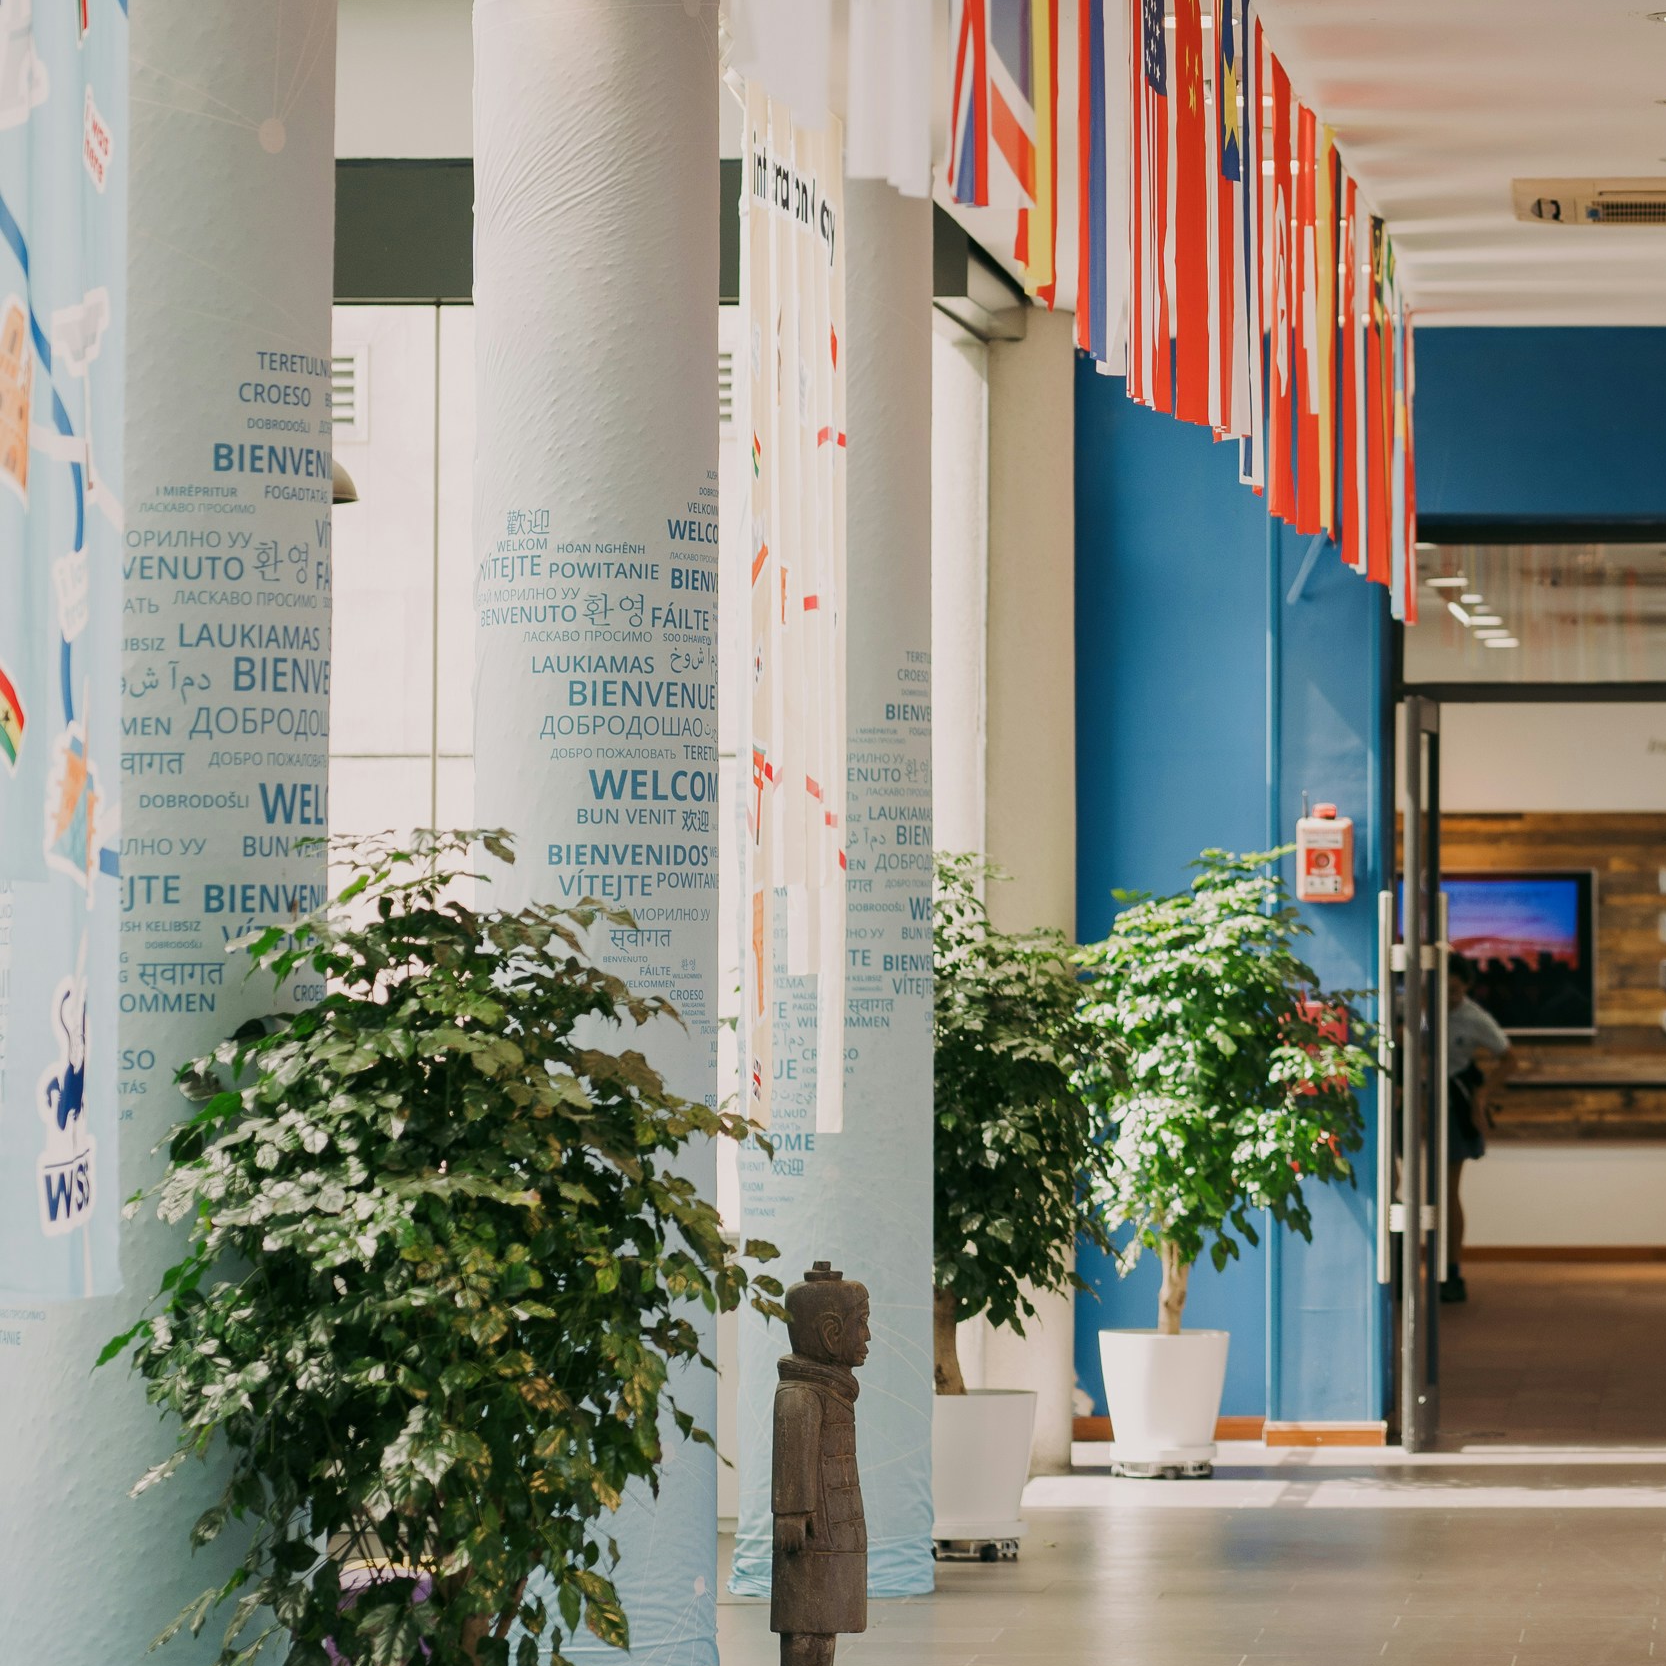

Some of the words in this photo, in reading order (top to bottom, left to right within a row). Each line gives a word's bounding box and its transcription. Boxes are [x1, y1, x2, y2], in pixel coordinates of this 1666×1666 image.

[239, 382, 311, 407] CROESO
[163, 483, 238, 498] MIRËPRITUR
[264, 485, 328, 504] FOGADTATÁS
[198, 503, 256, 516] ПРОСИМО
[497, 537, 548, 553] WELKOM
[557, 543, 591, 554] HOAN
[595, 541, 646, 555] NGHÊNH
[480, 553, 541, 583] VÍTEJTE
[549, 562, 660, 581] POWITANIE
[171, 590, 252, 605] ЛАСКАВО
[256, 592, 317, 608] ПРОСИМО
[494, 587, 557, 603] МОРИЛНО
[481, 604, 577, 627] BENVENUTO
[582, 592, 644, 628] 환영
[651, 601, 709, 631] FÁILTE
[121, 637, 166, 651] IBSIZ
[178, 622, 320, 651] LAUKIAMAS
[523, 630, 580, 643] ЛАСКАВО
[584, 630, 653, 643] ПРОСИМО
[662, 632, 681, 643] SOO
[531, 655, 655, 675] LAUKIAMAS
[568, 680, 716, 711] BIENVENUE
[539, 715, 703, 741] ДОБРОДОШАО
[208, 751, 262, 768] ДОБРО
[550, 748, 593, 760] ДОБРО
[596, 747, 677, 760] ПОЖАЛОВАТЬ
[139, 792, 249, 809] DOBRODOŠLI
[259, 782, 328, 826] WEL
[577, 808, 619, 824] BUN
[625, 808, 677, 825] VENIT
[681, 809, 710, 833] 欢迎
[242, 836, 289, 858] BUN
[547, 844, 709, 867] BIENVENIDOS
[119, 875, 181, 912] JTE
[558, 869, 652, 902] VÍTEJTE
[632, 907, 698, 922] МОРИЛНО
[848, 901, 905, 912] DOBRODOŠLI
[146, 920, 201, 933] KELIBSIZ
[602, 955, 649, 964] BENVENUTO
[639, 964, 671, 976] FÁILTE
[669, 989, 704, 1001] CROESO
[772, 1158, 805, 1177] 欢迎
